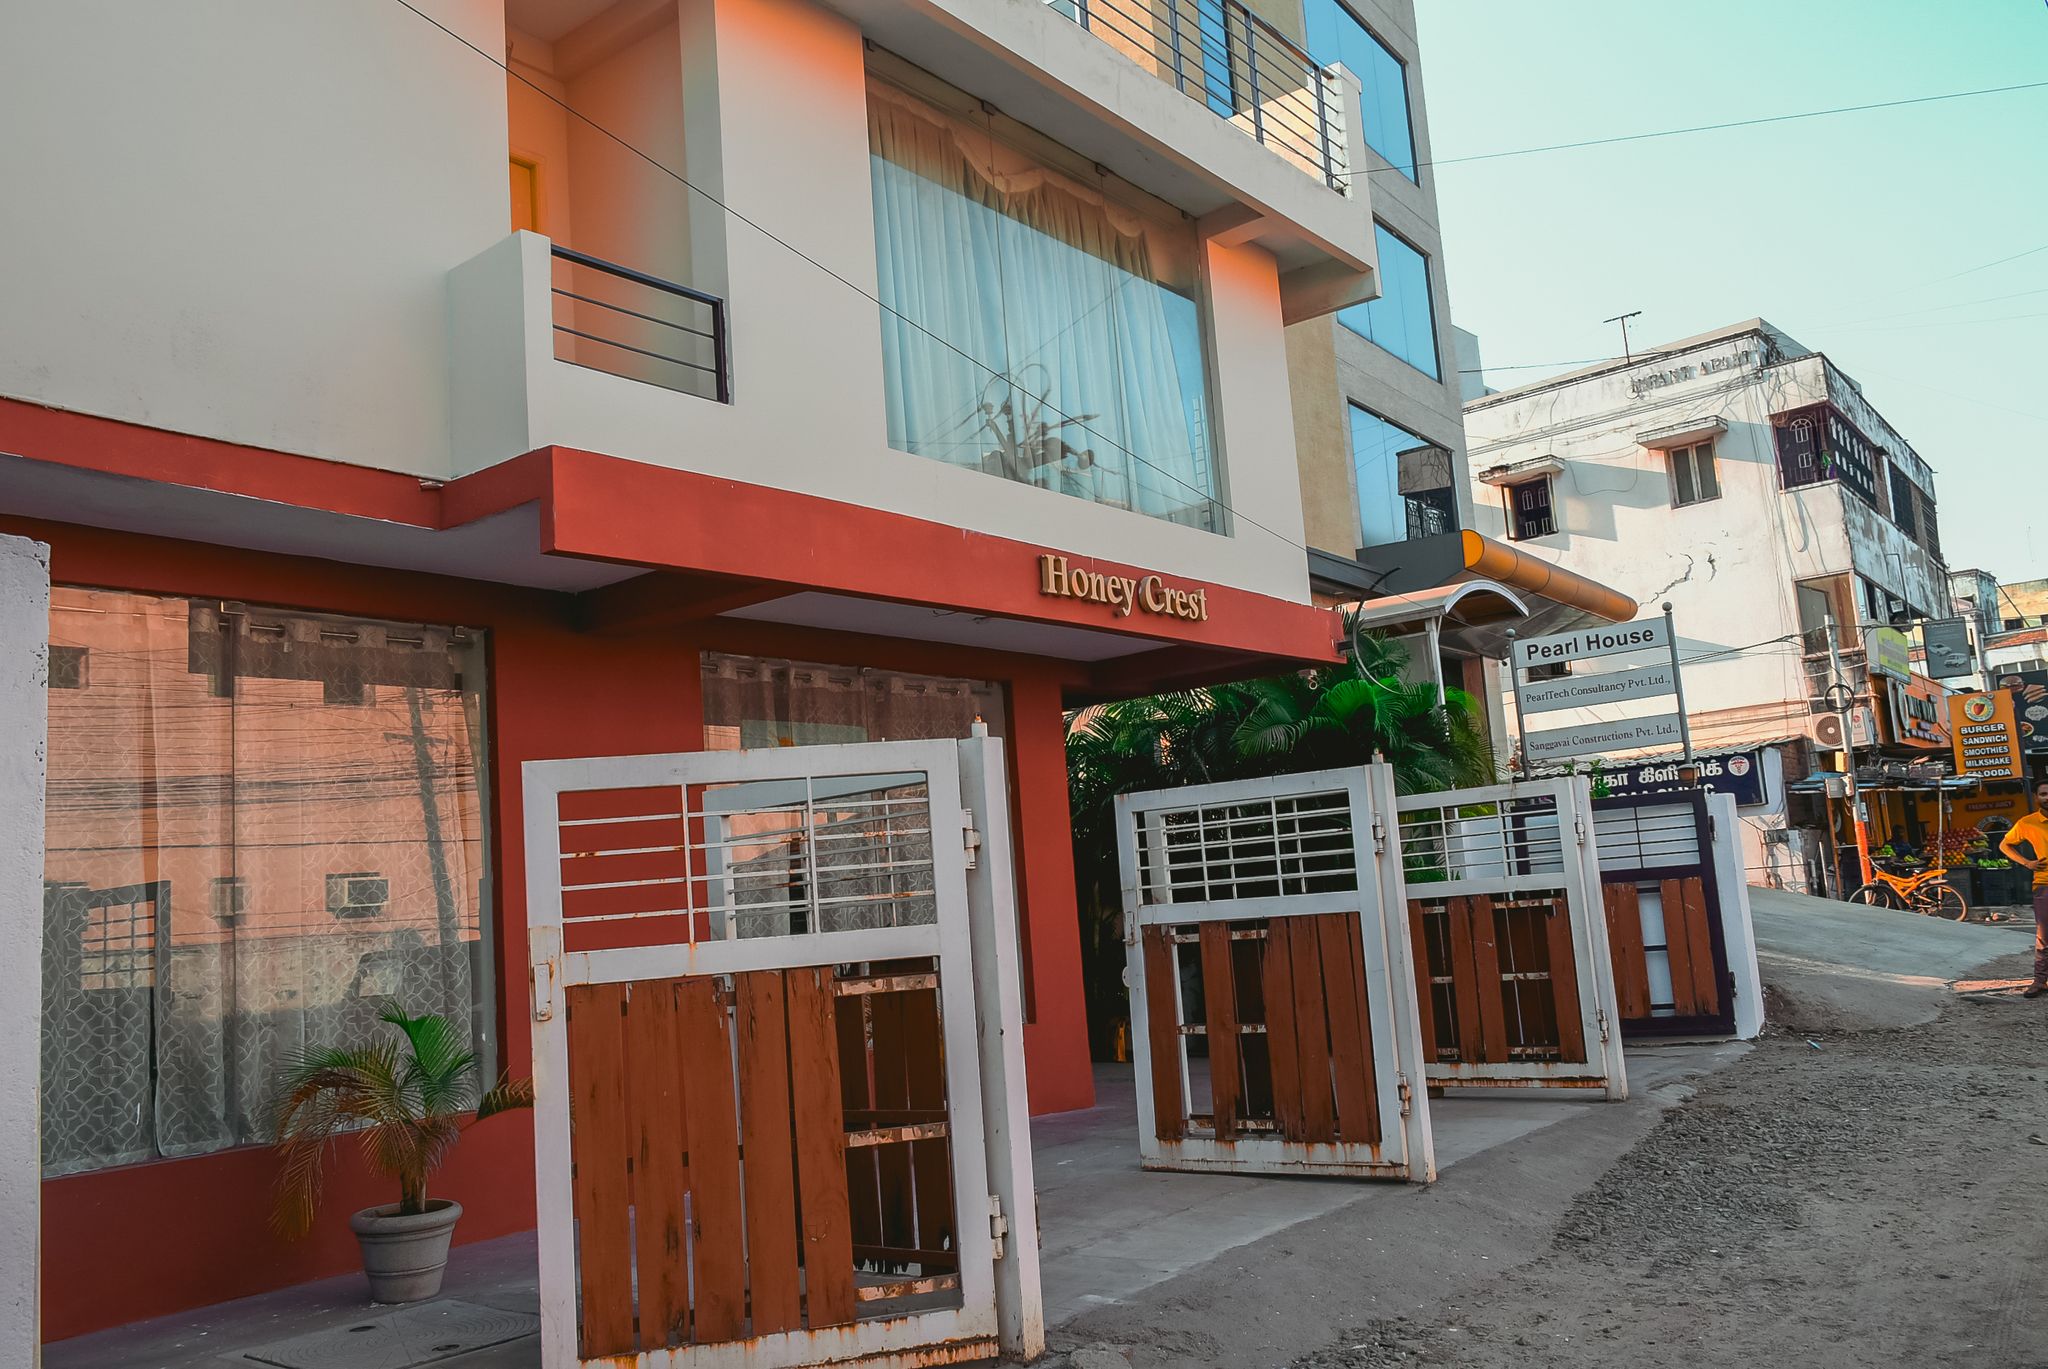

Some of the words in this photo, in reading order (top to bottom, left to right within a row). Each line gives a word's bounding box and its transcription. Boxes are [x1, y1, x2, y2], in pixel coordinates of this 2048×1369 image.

[1041, 554, 1137, 617] Honey
[1138, 574, 1208, 621] Crest
[1526, 637, 1578, 661] Pearl
[1586, 629, 1655, 655] House
[1525, 686, 1570, 703] PearlTech
[1571, 682, 1626, 697] Consultancy
[1628, 679, 1647, 689] Pvt.
[1960, 723, 2006, 734] BURGER
[1529, 736, 1570, 752] Sanggavai
[1572, 731, 1633, 746] Constructions
[1635, 727, 1654, 738] Pvt.
[1962, 734, 2008, 746] SANDWICH
[1963, 745, 2009, 757] SMOOTHIES
[1965, 756, 2011, 768] MILKSHAKE
[1966, 768, 2011, 777] OODA
